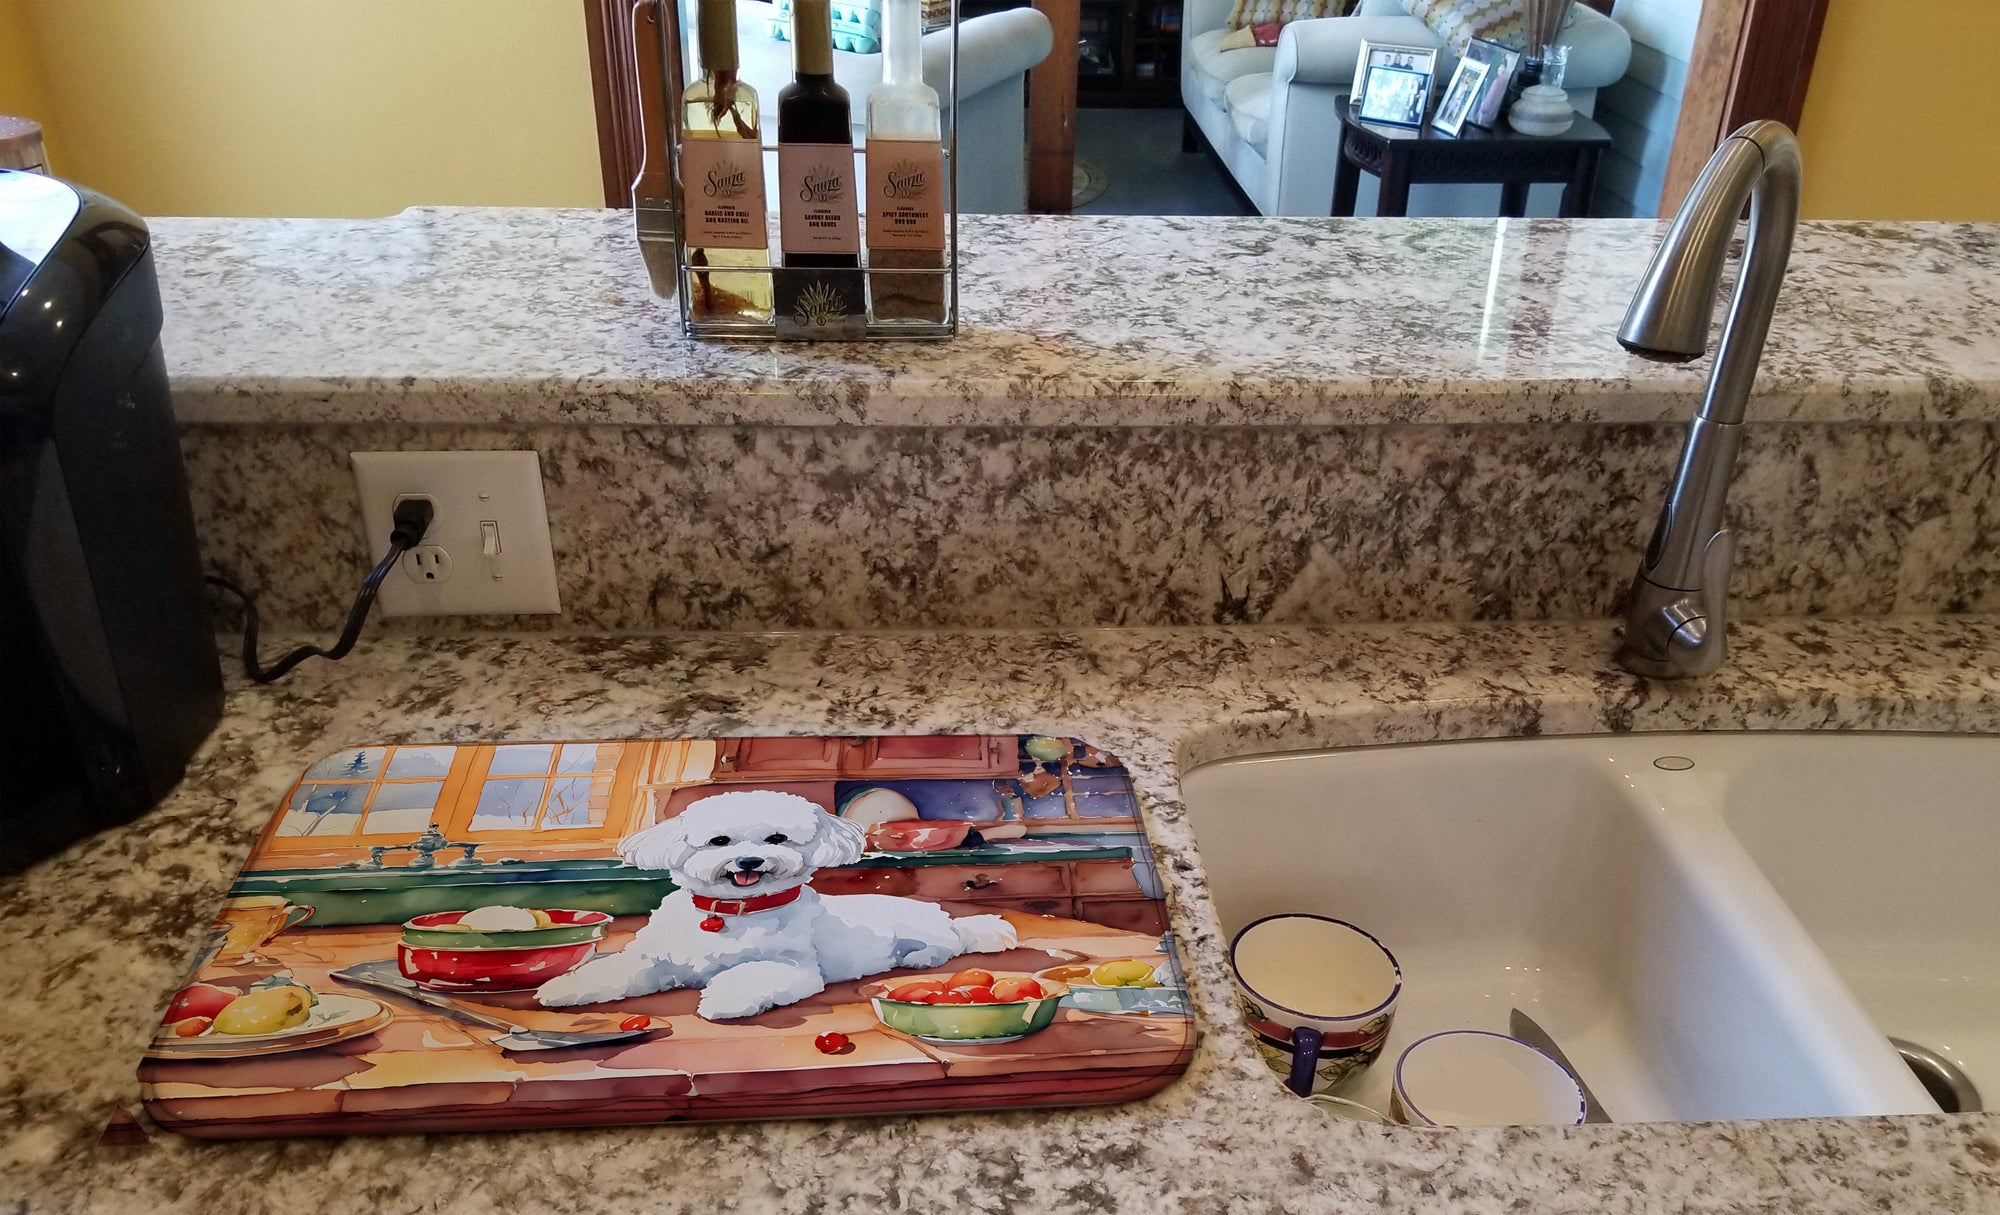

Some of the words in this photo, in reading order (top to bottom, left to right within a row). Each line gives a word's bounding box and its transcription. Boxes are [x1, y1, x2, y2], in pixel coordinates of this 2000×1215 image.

[703, 170, 746, 197] Sauza
[800, 175, 842, 202] Sauza
[883, 171, 926, 198] Sauza
